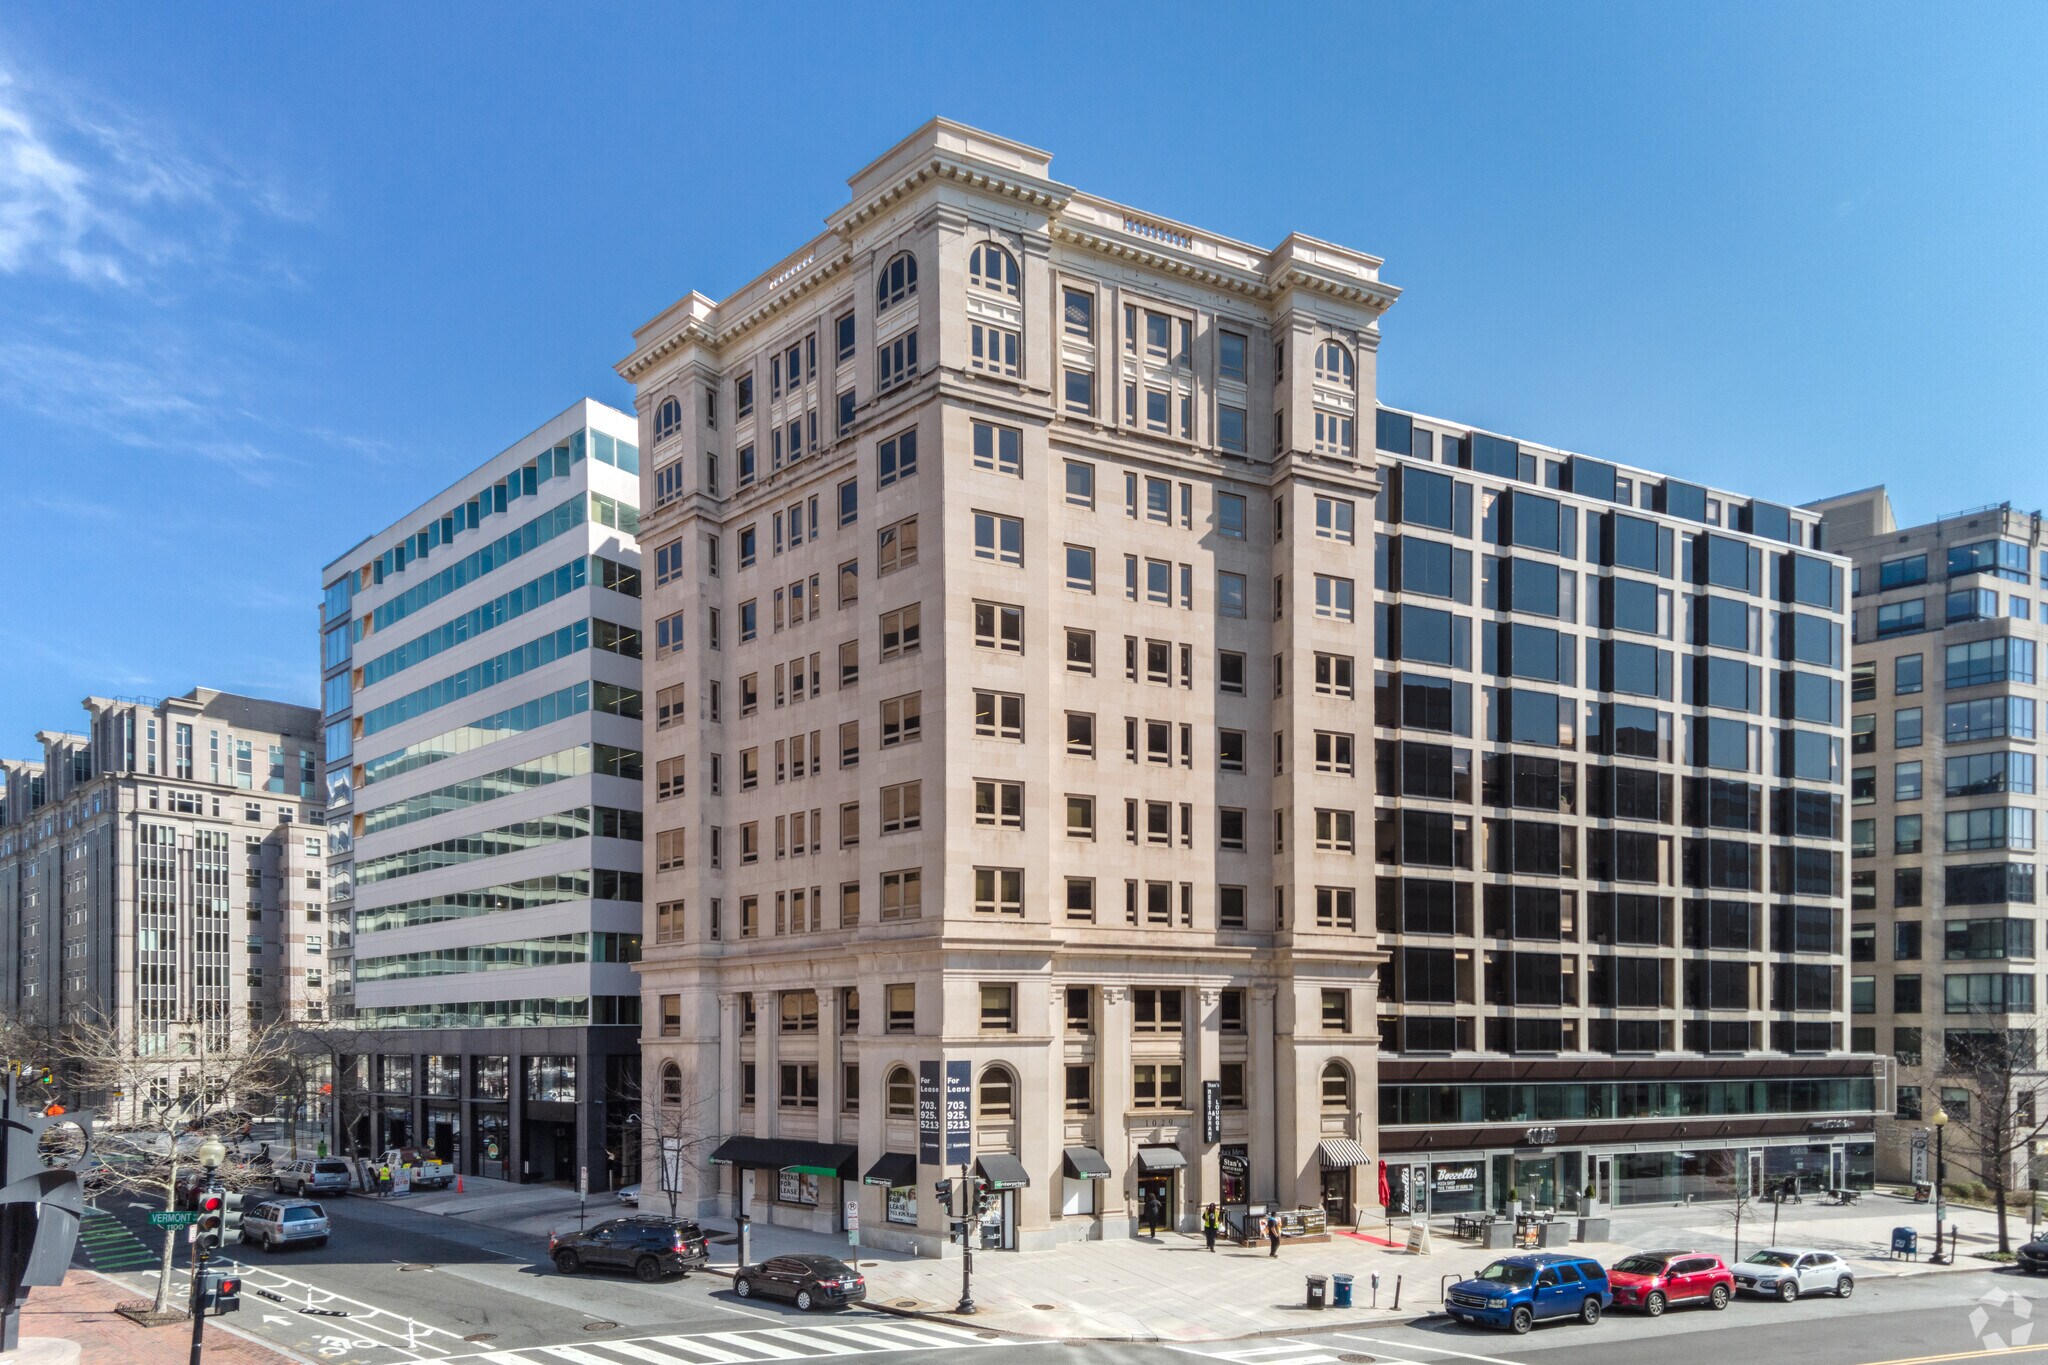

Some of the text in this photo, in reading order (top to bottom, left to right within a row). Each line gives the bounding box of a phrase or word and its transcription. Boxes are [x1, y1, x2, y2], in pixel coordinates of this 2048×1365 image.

[920, 1101, 937, 1110] 703.
[947, 1101, 967, 1110] 703.
[920, 1111, 937, 1119] 925.
[947, 1111, 967, 1120] 925.
[920, 1120, 939, 1129] 5213
[947, 1120, 970, 1130] 5213
[1145, 1119, 1173, 1127] 1029
[1526, 1127, 1556, 1145] 1025
[1223, 1158, 1242, 1168] Stan's
[995, 1180, 1026, 1188] enterprise
[152, 1213, 191, 1222] VERMONT
